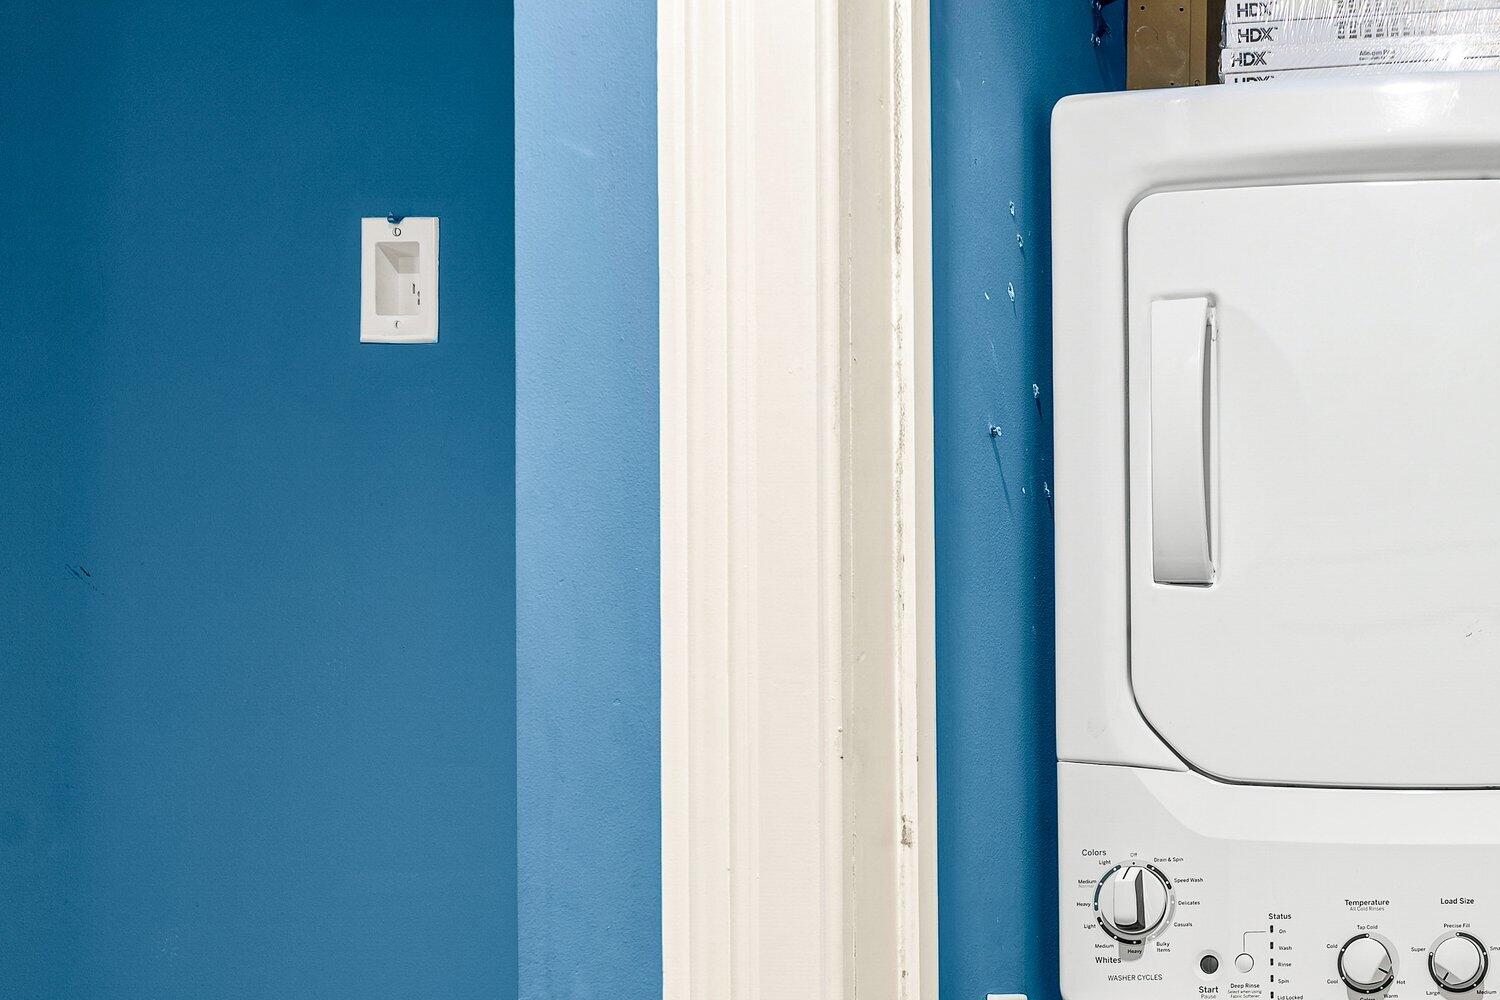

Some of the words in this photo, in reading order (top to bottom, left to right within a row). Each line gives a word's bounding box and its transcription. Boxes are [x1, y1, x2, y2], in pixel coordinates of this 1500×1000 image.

[1237, 2, 1272, 17] HDX
[1238, 27, 1274, 43] HDX
[1231, 51, 1267, 67] HDX
[1082, 848, 1107, 856] Colors
[1344, 899, 1390, 908] Temperature
[1440, 897, 1458, 905] Load
[1460, 897, 1475, 905] Size
[1268, 912, 1292, 920] Status
[1095, 956, 1122, 964] Whites
[1108, 974, 1136, 982] WASHER
[1137, 974, 1163, 982] CYCLES
[1199, 985, 1219, 993] Start
